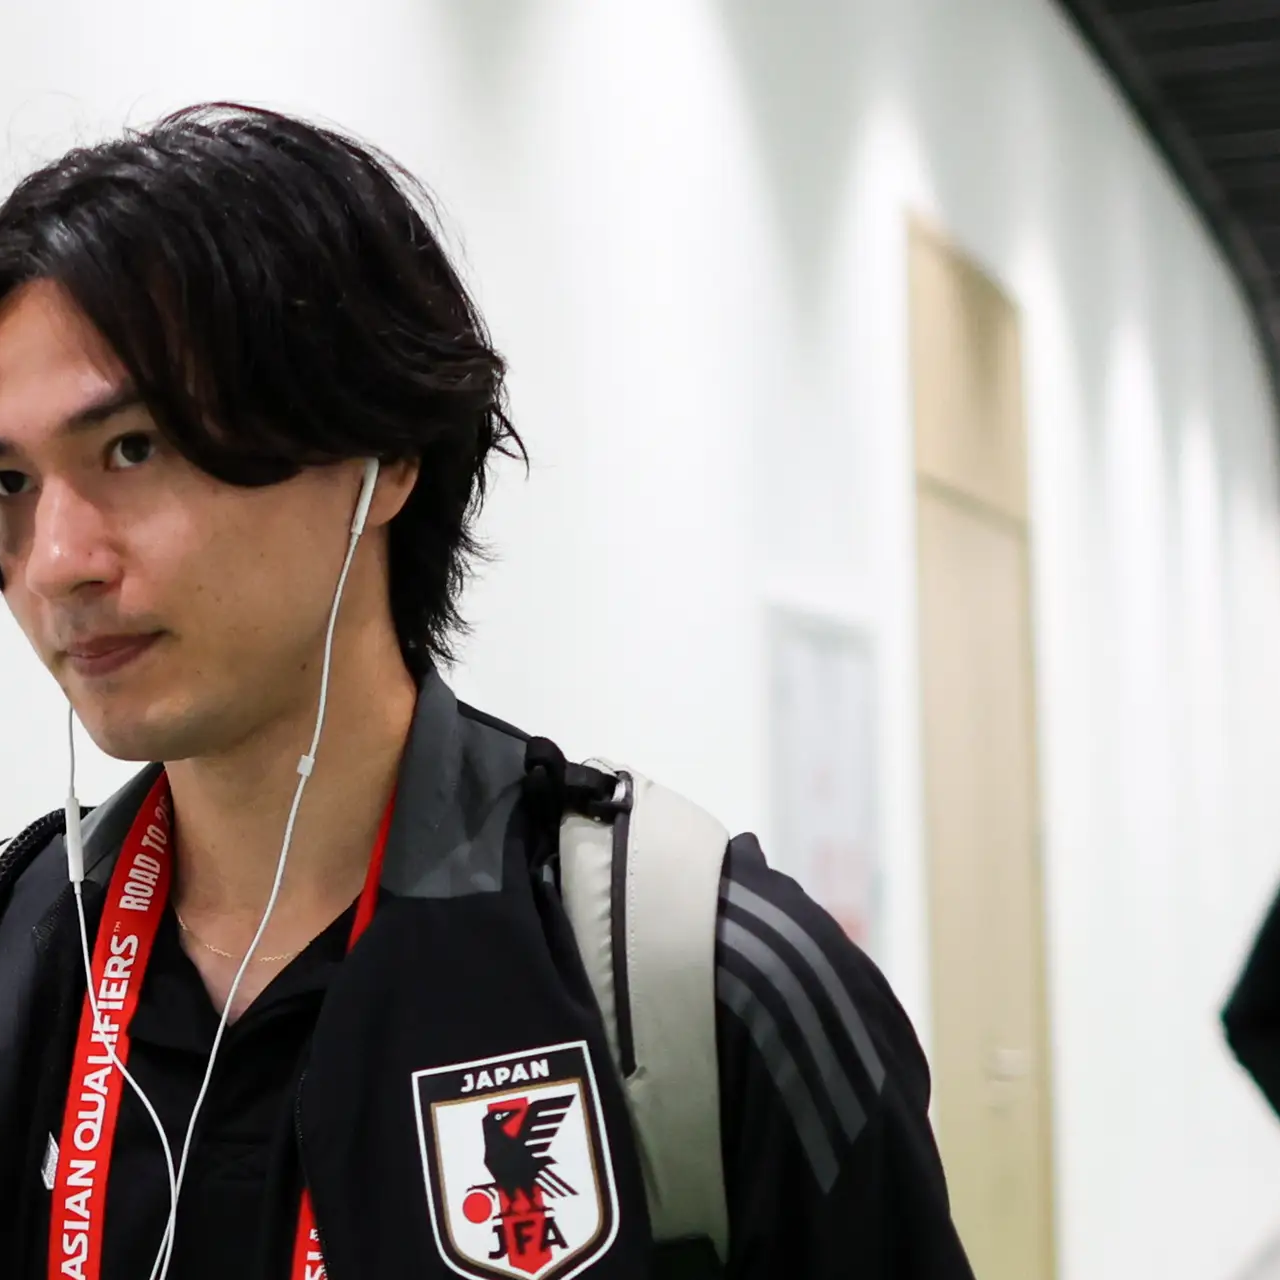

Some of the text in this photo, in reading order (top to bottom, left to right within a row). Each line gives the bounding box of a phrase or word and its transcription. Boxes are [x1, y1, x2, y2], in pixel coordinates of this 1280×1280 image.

[119, 853, 161, 912] ROAD
[141, 824, 167, 854] TO
[461, 1059, 550, 1093] JAPAN
[488, 1217, 568, 1260] JFA
